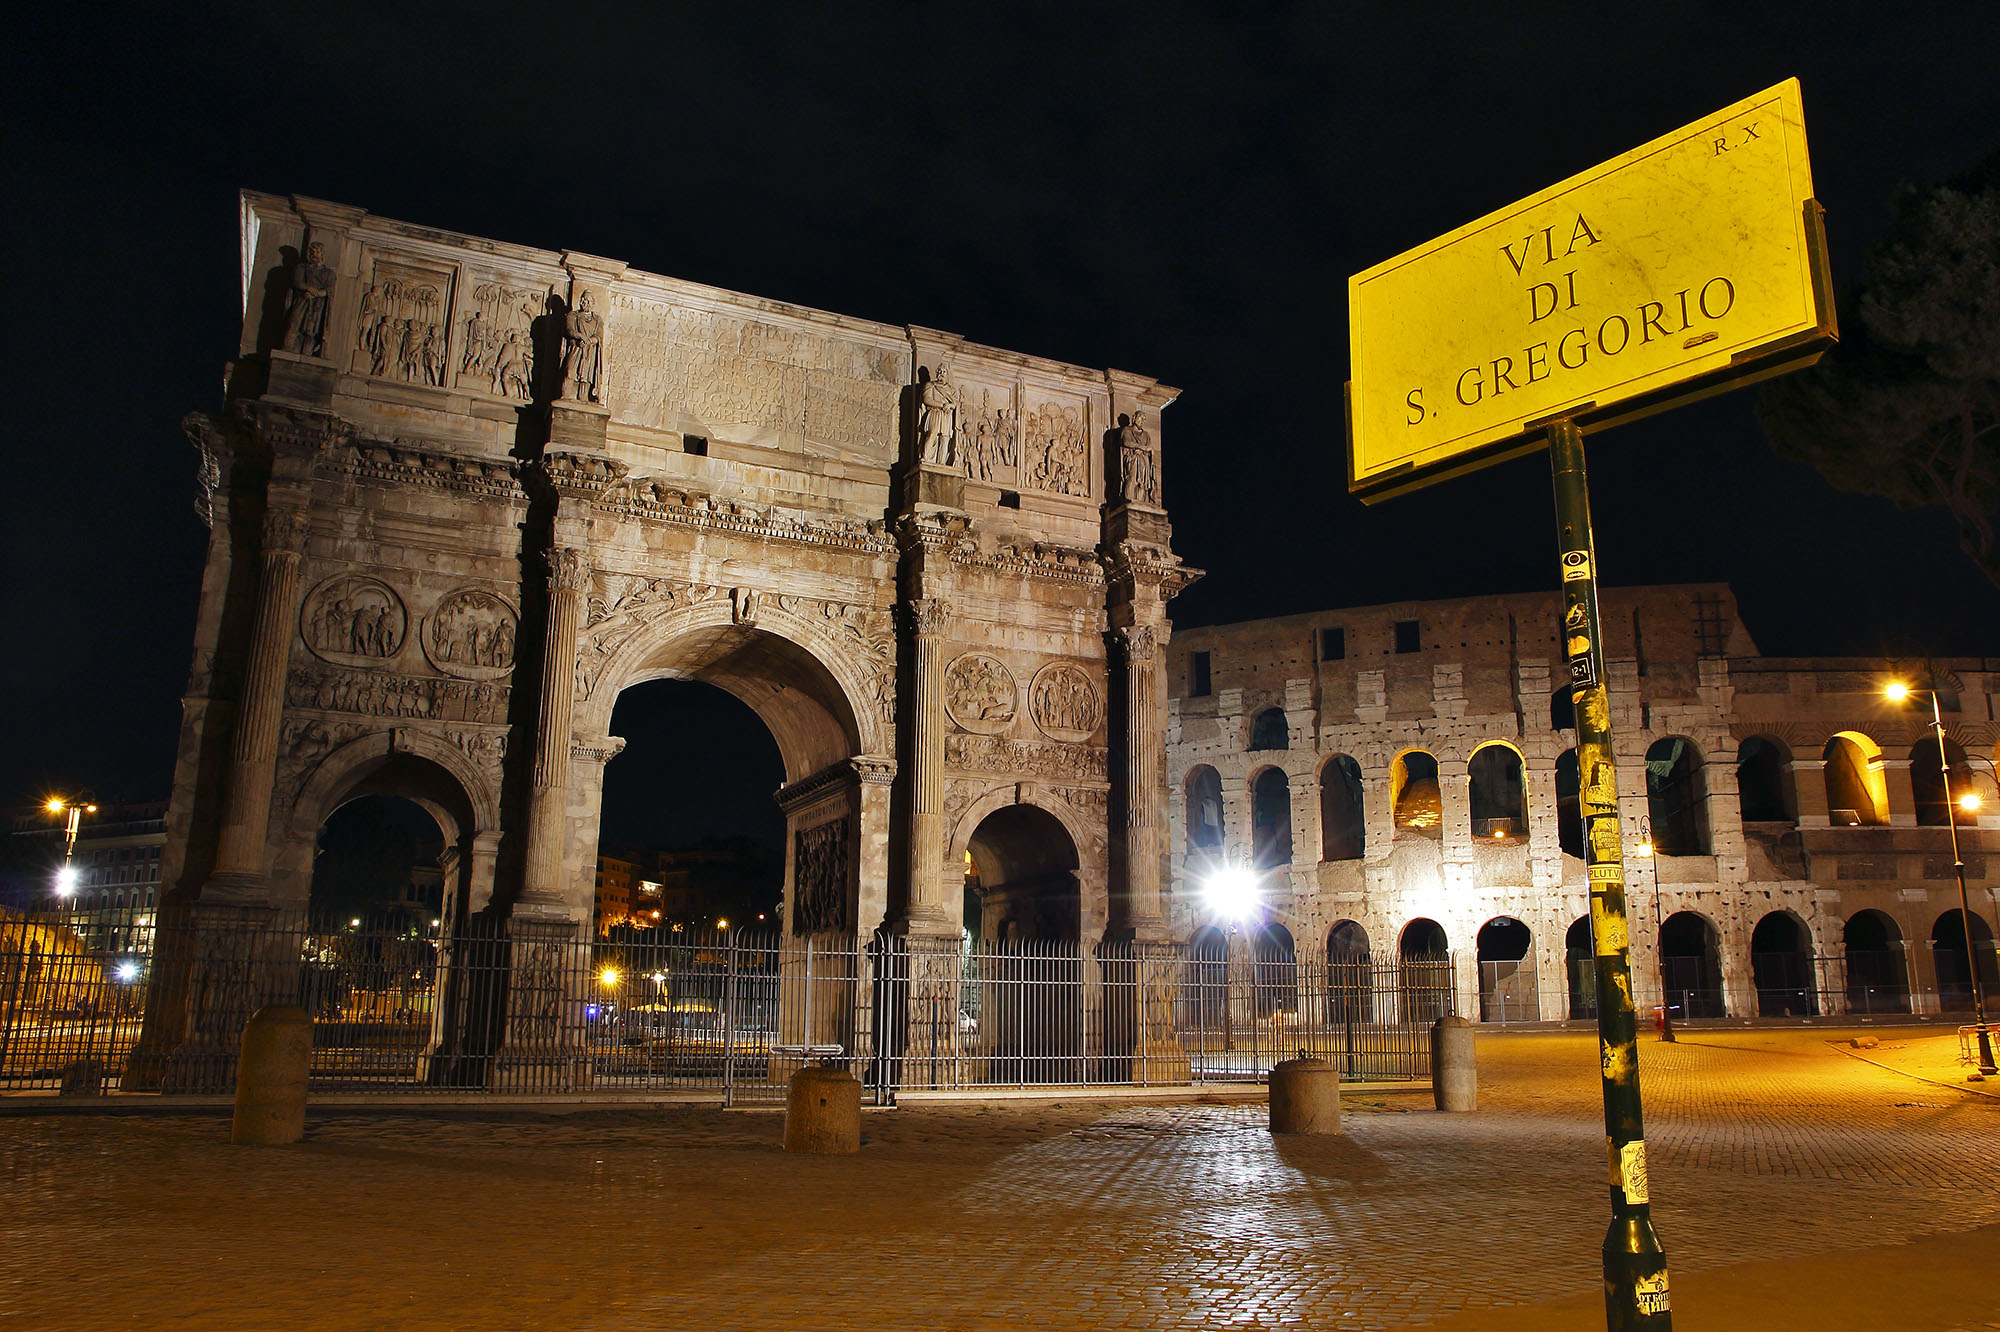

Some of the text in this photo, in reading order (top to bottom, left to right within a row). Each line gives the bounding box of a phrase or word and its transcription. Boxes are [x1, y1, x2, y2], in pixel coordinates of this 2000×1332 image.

[1500, 213, 1602, 277] VIA
[1526, 269, 1581, 325] DI
[1406, 276, 1736, 428] S. GREGORIO
